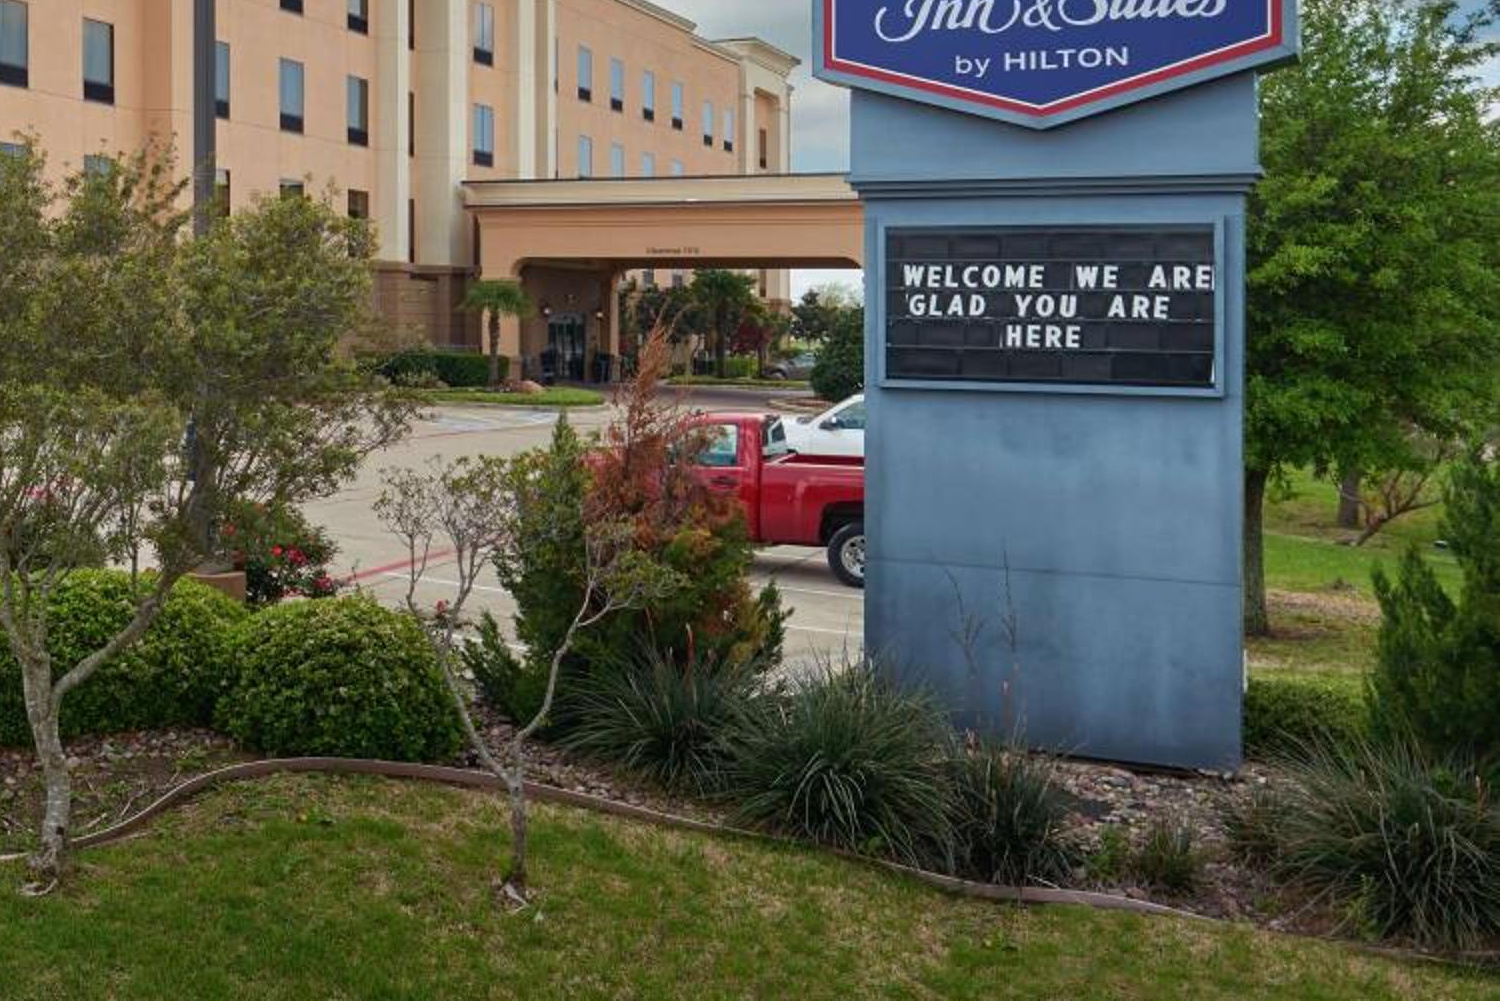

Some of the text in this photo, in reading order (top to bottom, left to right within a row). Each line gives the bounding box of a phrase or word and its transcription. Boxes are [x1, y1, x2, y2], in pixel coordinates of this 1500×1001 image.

[954, 46, 1130, 78] by HILTON
[902, 264, 1213, 290] WELCOME WE ARE
[908, 294, 1171, 320] GLAD YOU ARE
[1005, 324, 1082, 349] HERE
